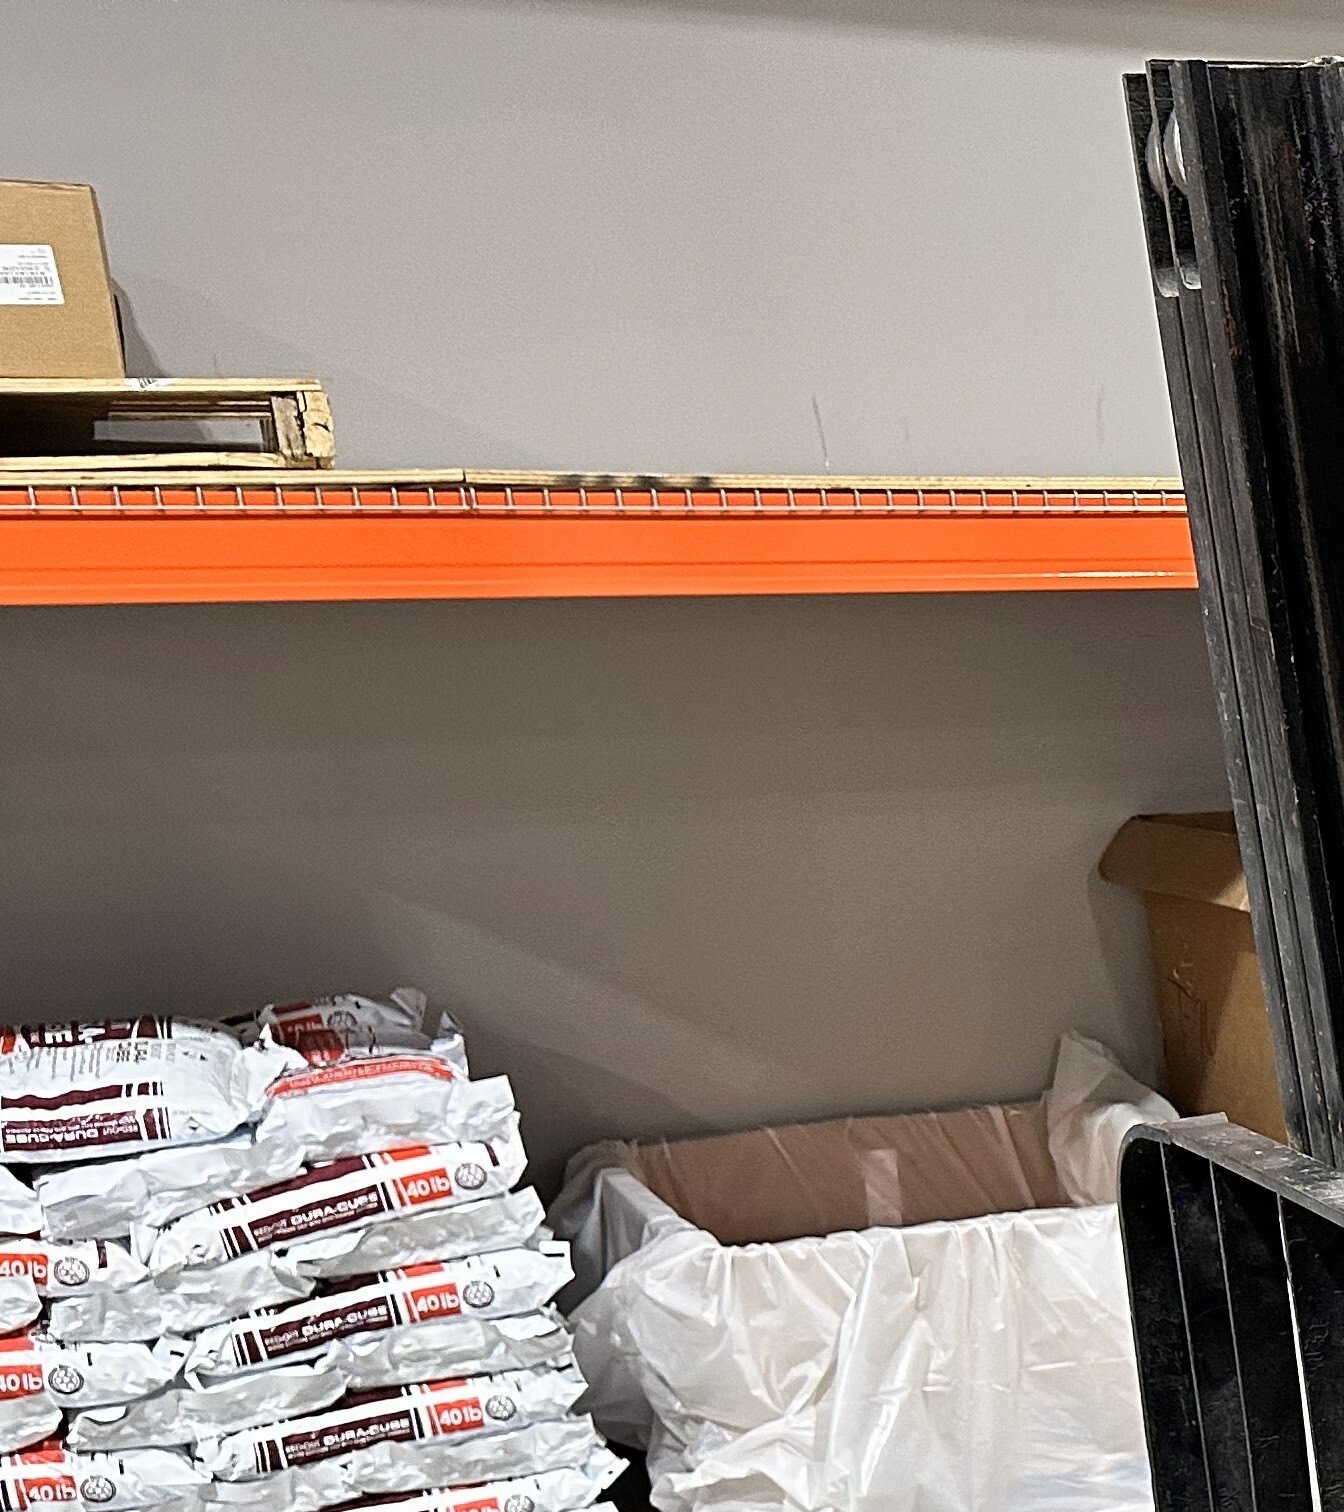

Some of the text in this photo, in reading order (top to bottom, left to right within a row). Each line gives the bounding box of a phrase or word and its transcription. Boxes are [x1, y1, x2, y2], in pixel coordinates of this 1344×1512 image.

[405, 1176, 450, 1199] 40 lb
[416, 1293, 460, 1313] 40 lb
[438, 1405, 483, 1427] 40 lb
[28, 1484, 54, 1501] 40
